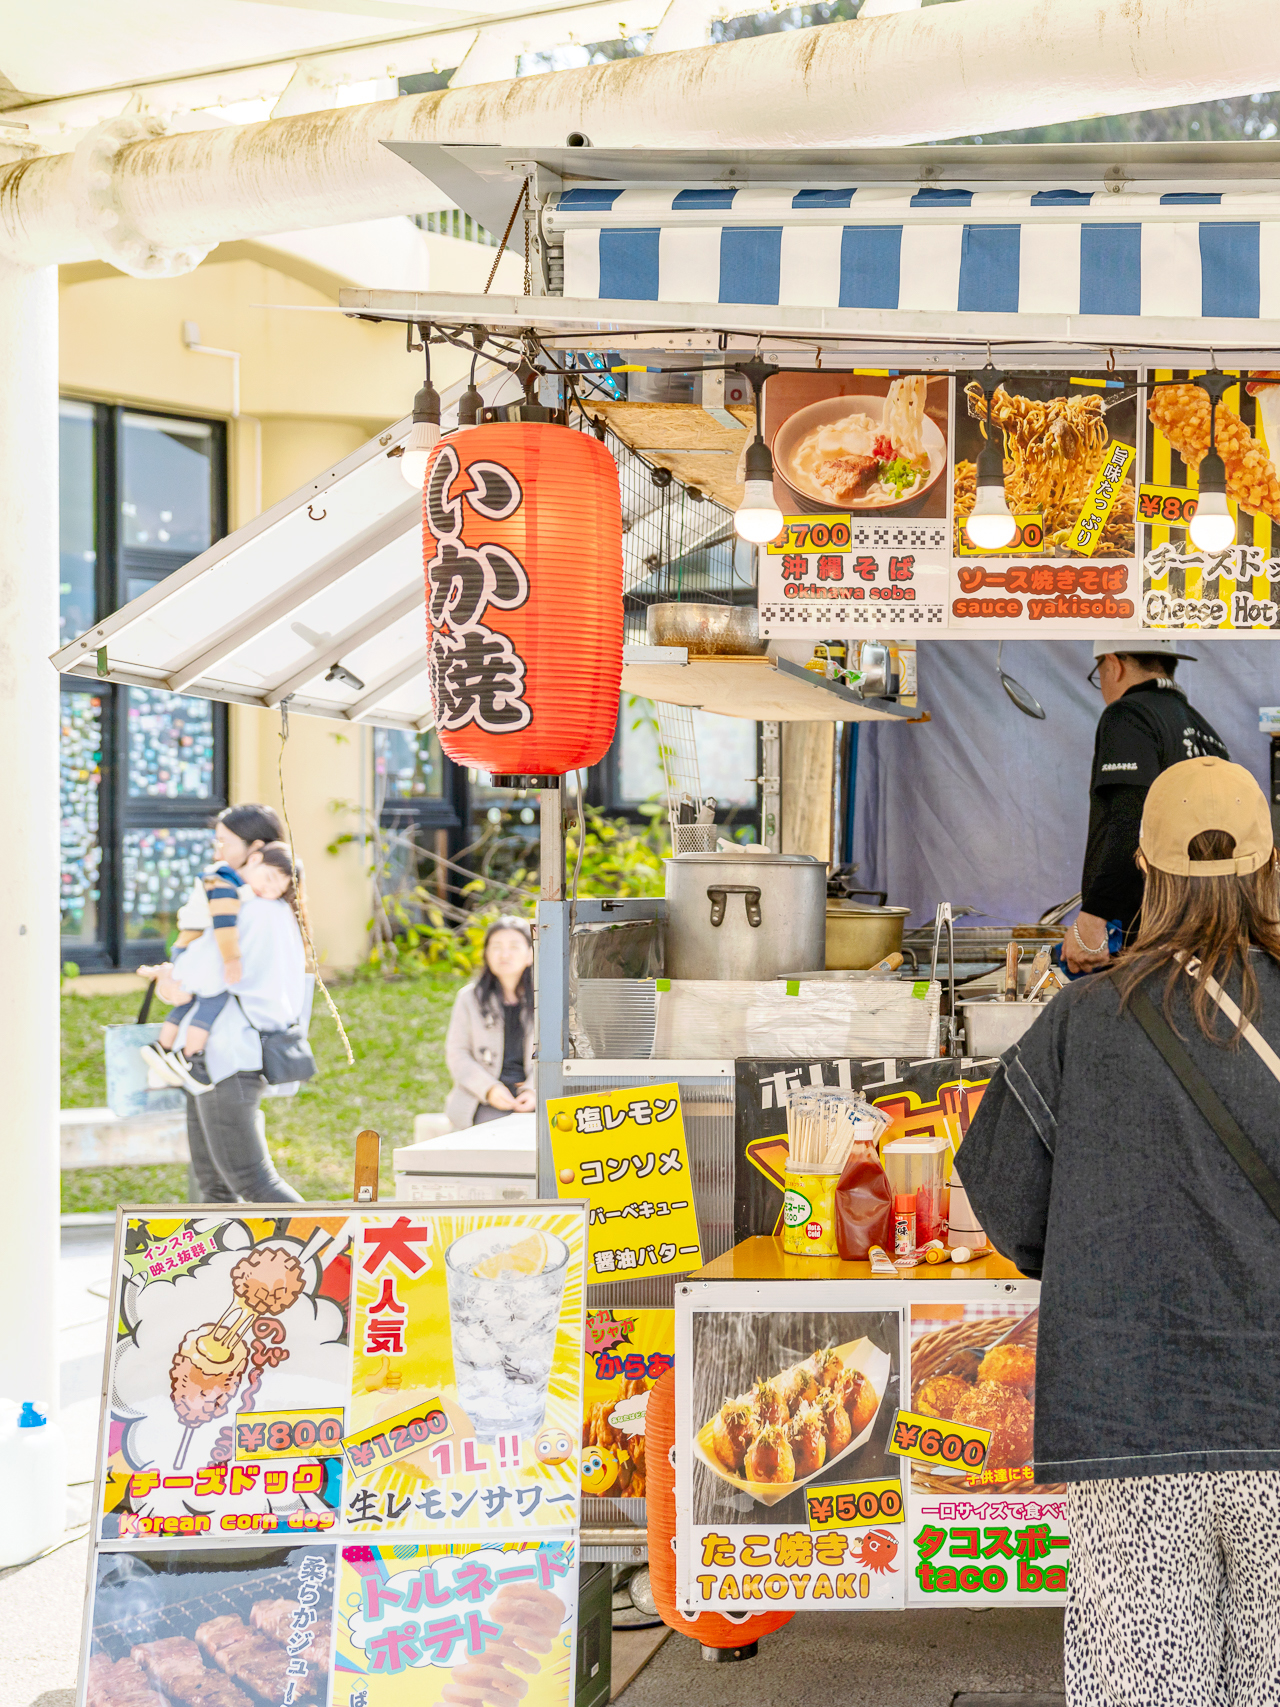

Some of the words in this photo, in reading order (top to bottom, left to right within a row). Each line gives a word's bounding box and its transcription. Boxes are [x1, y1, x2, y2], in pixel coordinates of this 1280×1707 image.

[1078, 447, 1129, 547] 旨味たっぷり
[781, 555, 916, 581] 沖縄そば
[958, 566, 1128, 594] ソース焼きそば
[427, 445, 533, 733] いか焼
[784, 583, 865, 599] Okinawa
[869, 585, 916, 600] soba
[954, 598, 1022, 617] sauce
[1027, 595, 1134, 620] yakisoba
[1146, 593, 1223, 622] Cheese
[1234, 595, 1273, 622] Hot
[575, 1099, 677, 1133] 塩レモン
[580, 1149, 682, 1185] コンソメ
[589, 1200, 688, 1226] バーベキュー
[144, 1230, 195, 1260] インスタ
[594, 1243, 699, 1274] 醤油バター
[362, 1217, 432, 1356] 大人気
[591, 1318, 636, 1345] シャカ
[596, 1352, 675, 1380] からあ
[237, 1418, 343, 1453] ¥800
[352, 1409, 450, 1468] ¥1200
[894, 1421, 986, 1467] ¥600
[130, 1463, 325, 1498] チーズドック
[119, 1512, 211, 1534] Korean
[220, 1513, 277, 1531] corn
[287, 1509, 336, 1530] dog
[347, 1485, 577, 1525] 生レモンサワー
[811, 1491, 902, 1523] ¥500
[701, 1532, 849, 1567] たこ焼き
[914, 1524, 1070, 1559] タコスボー
[361, 1550, 569, 1622] トルネード
[696, 1573, 870, 1600] TAKOYAKI
[916, 1561, 1008, 1592] taco
[1016, 1559, 1069, 1592] ba
[365, 1610, 504, 1676] ポテト
